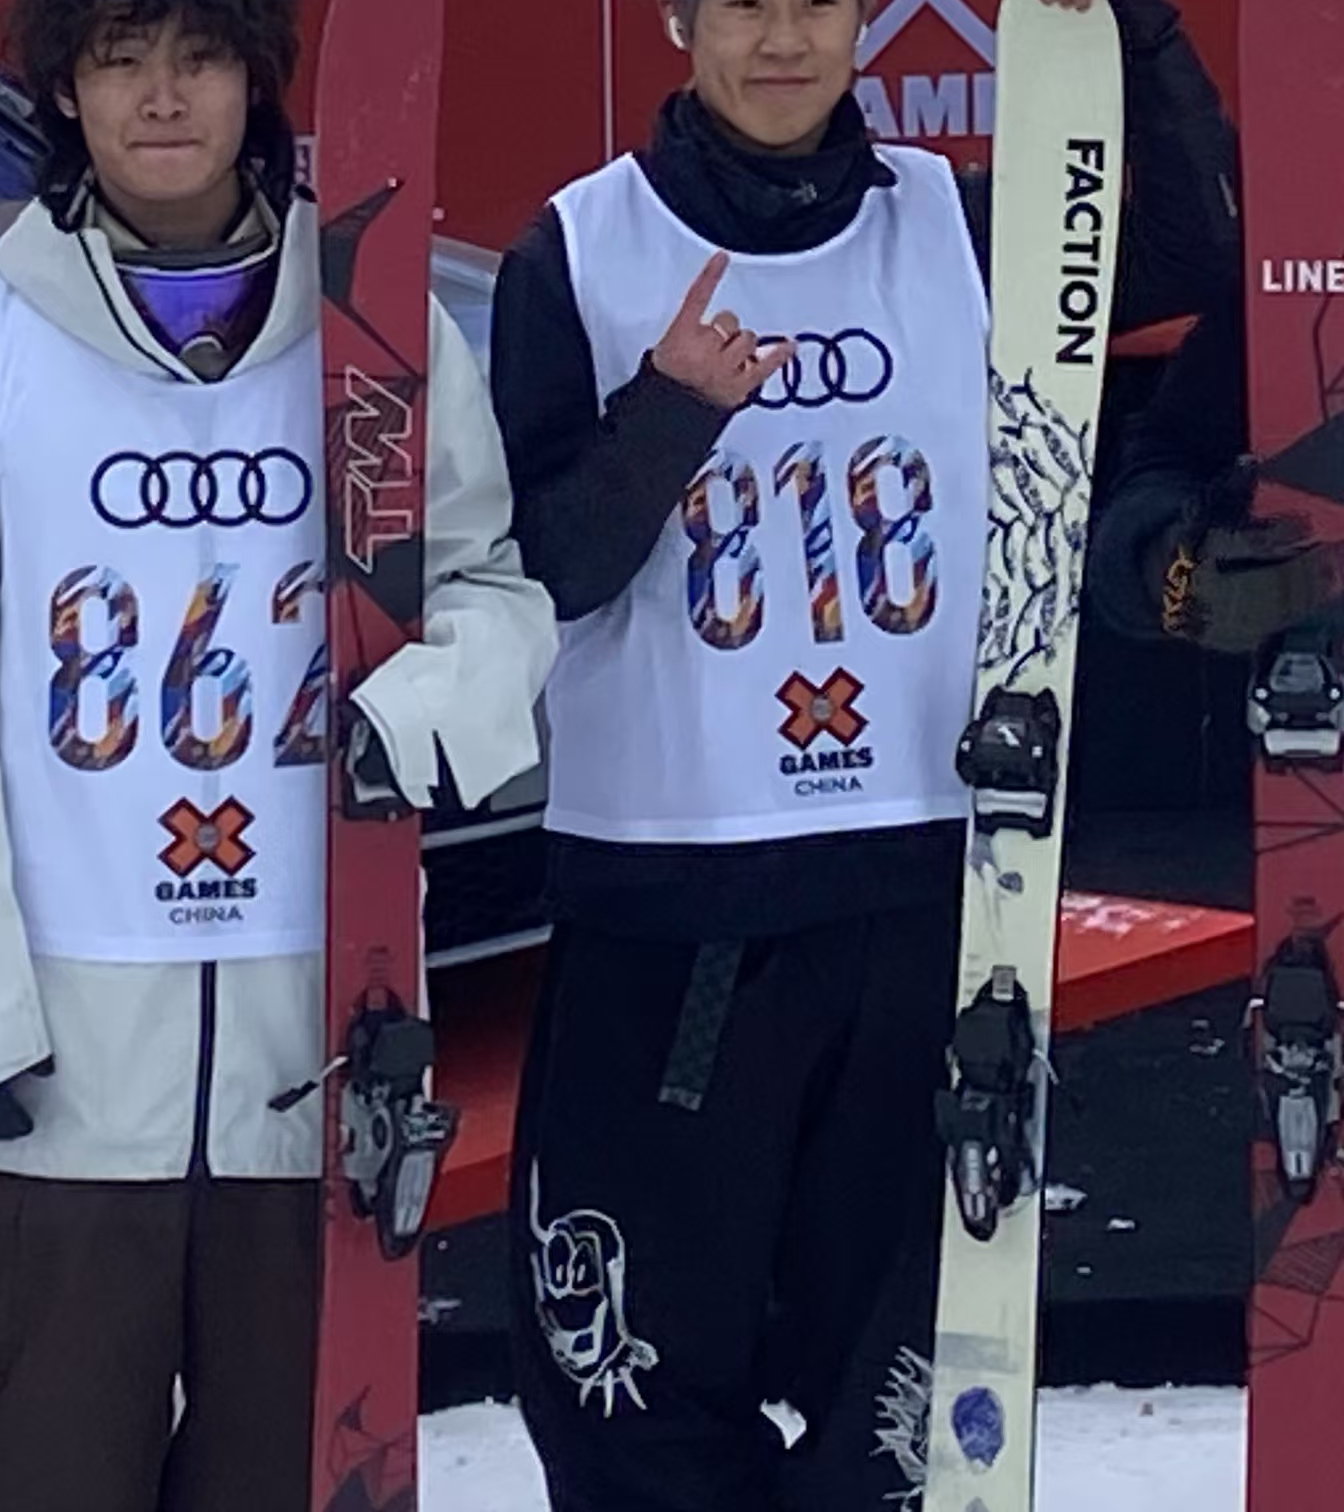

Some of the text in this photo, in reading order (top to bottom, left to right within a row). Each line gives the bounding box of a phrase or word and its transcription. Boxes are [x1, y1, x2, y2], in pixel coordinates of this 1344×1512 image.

[1055, 138, 1105, 365] FACTION
[682, 433, 938, 651] 818
[49, 561, 328, 773] 862
[779, 746, 874, 776] GAMES
[794, 775, 864, 796] CHINA
[155, 878, 258, 901] GAMES
[169, 905, 244, 924] CHINA
